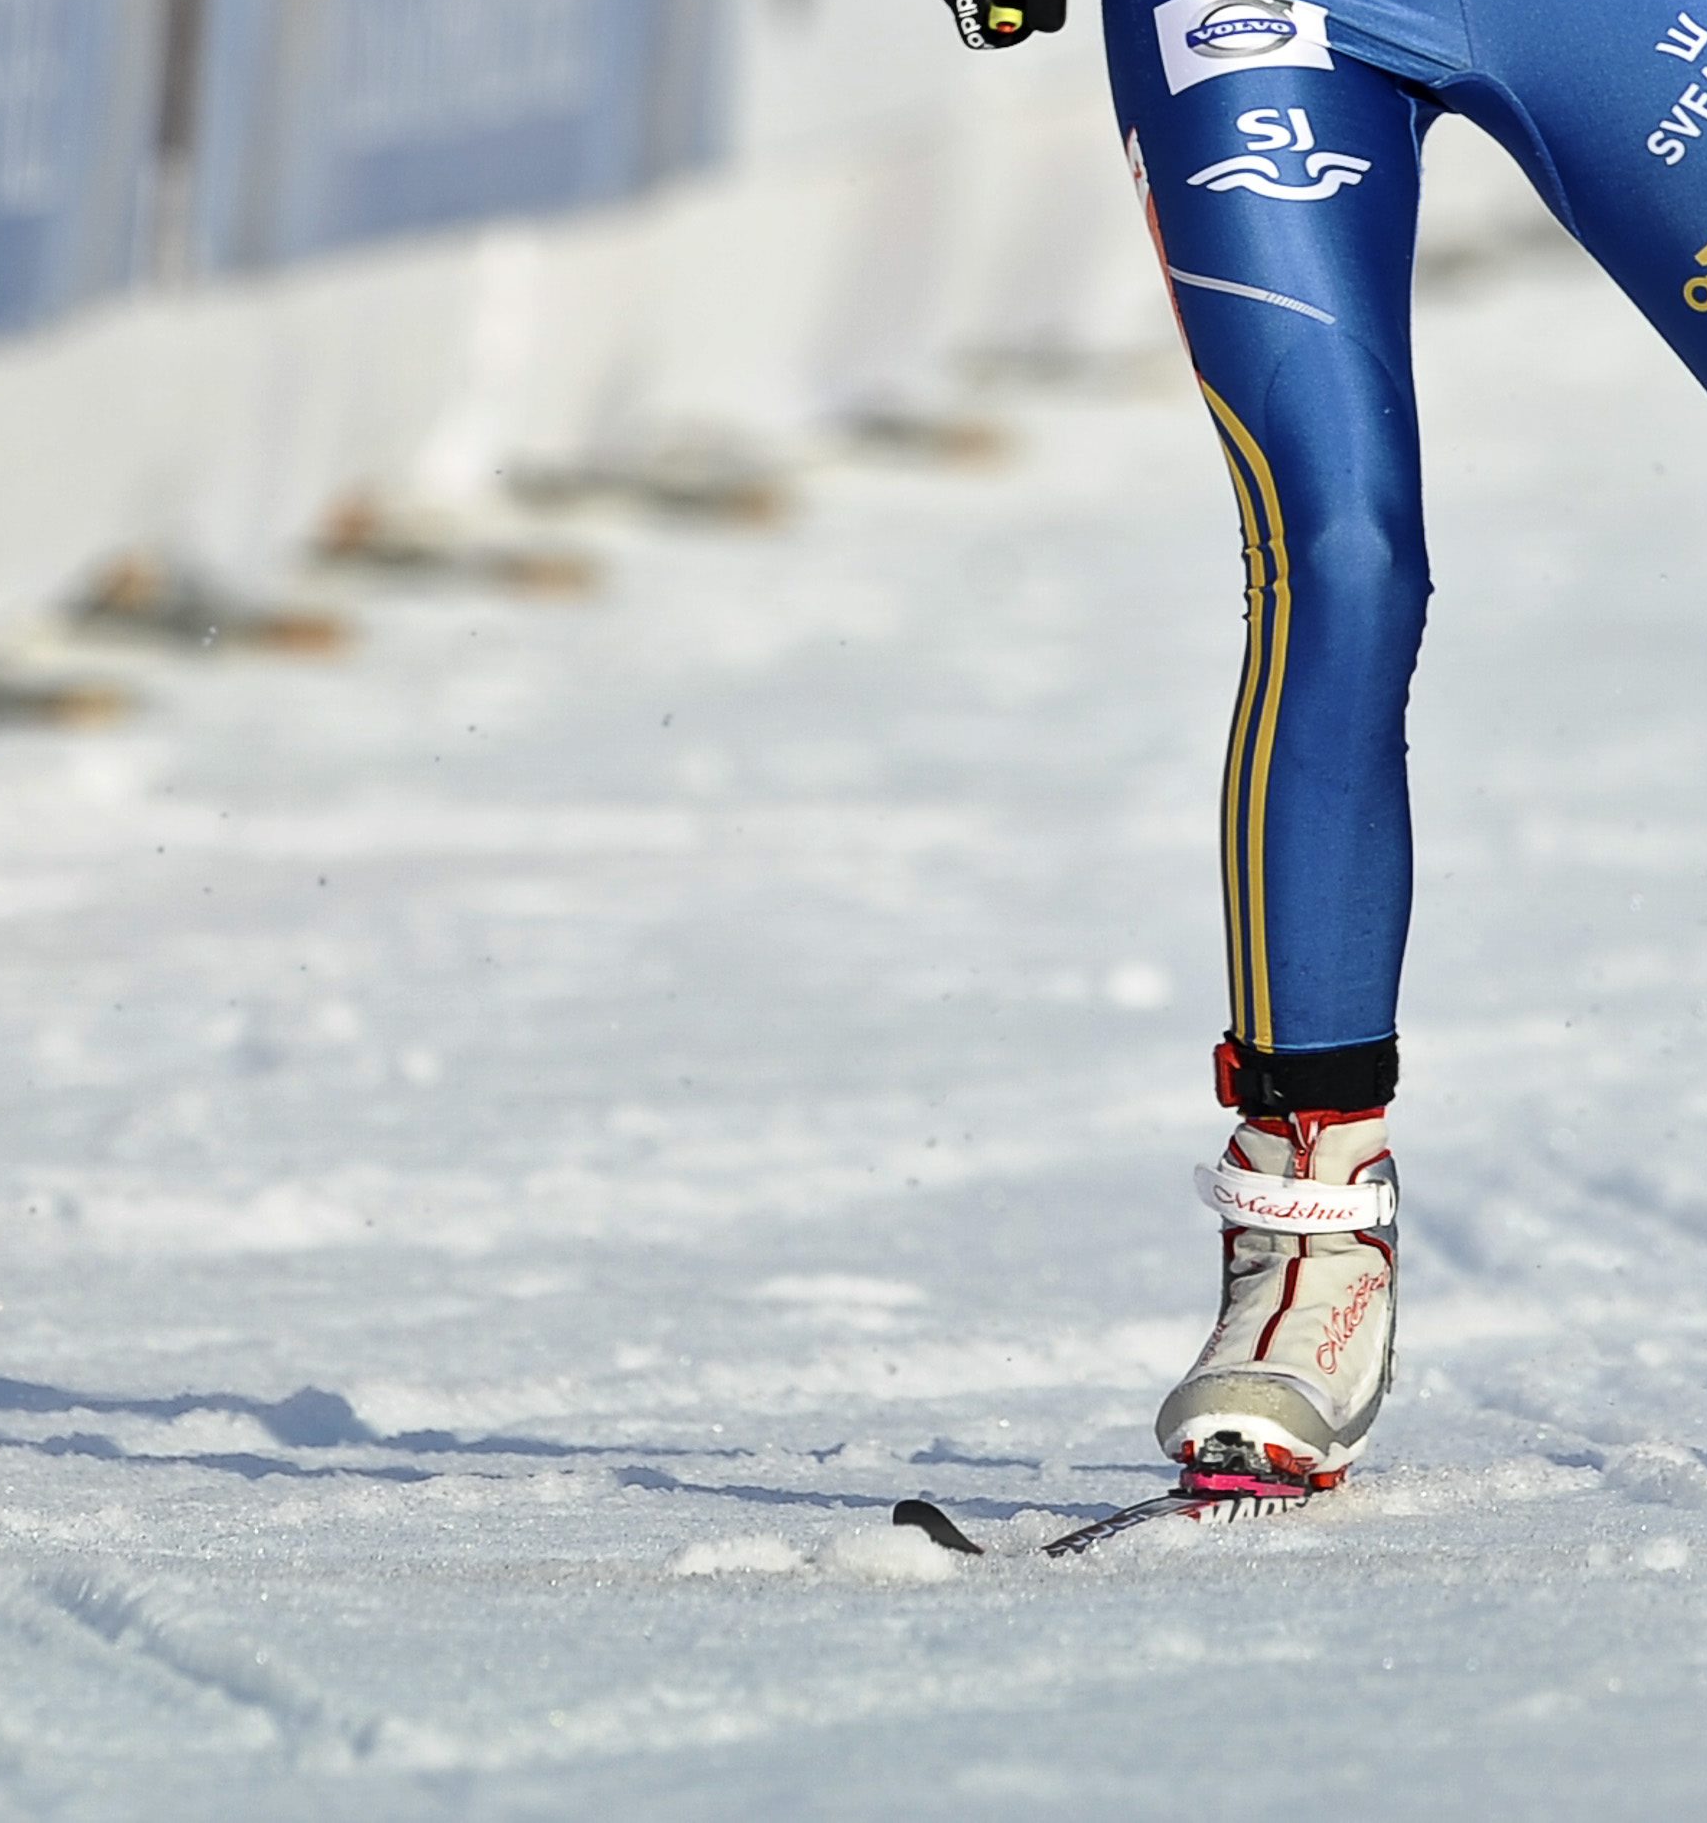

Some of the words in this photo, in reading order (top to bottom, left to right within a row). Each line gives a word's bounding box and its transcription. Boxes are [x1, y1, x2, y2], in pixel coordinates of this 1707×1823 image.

[1193, 20, 1291, 42] VOLVO
[1236, 108, 1315, 152] SJ
[1213, 1184, 1360, 1223] Madshus
